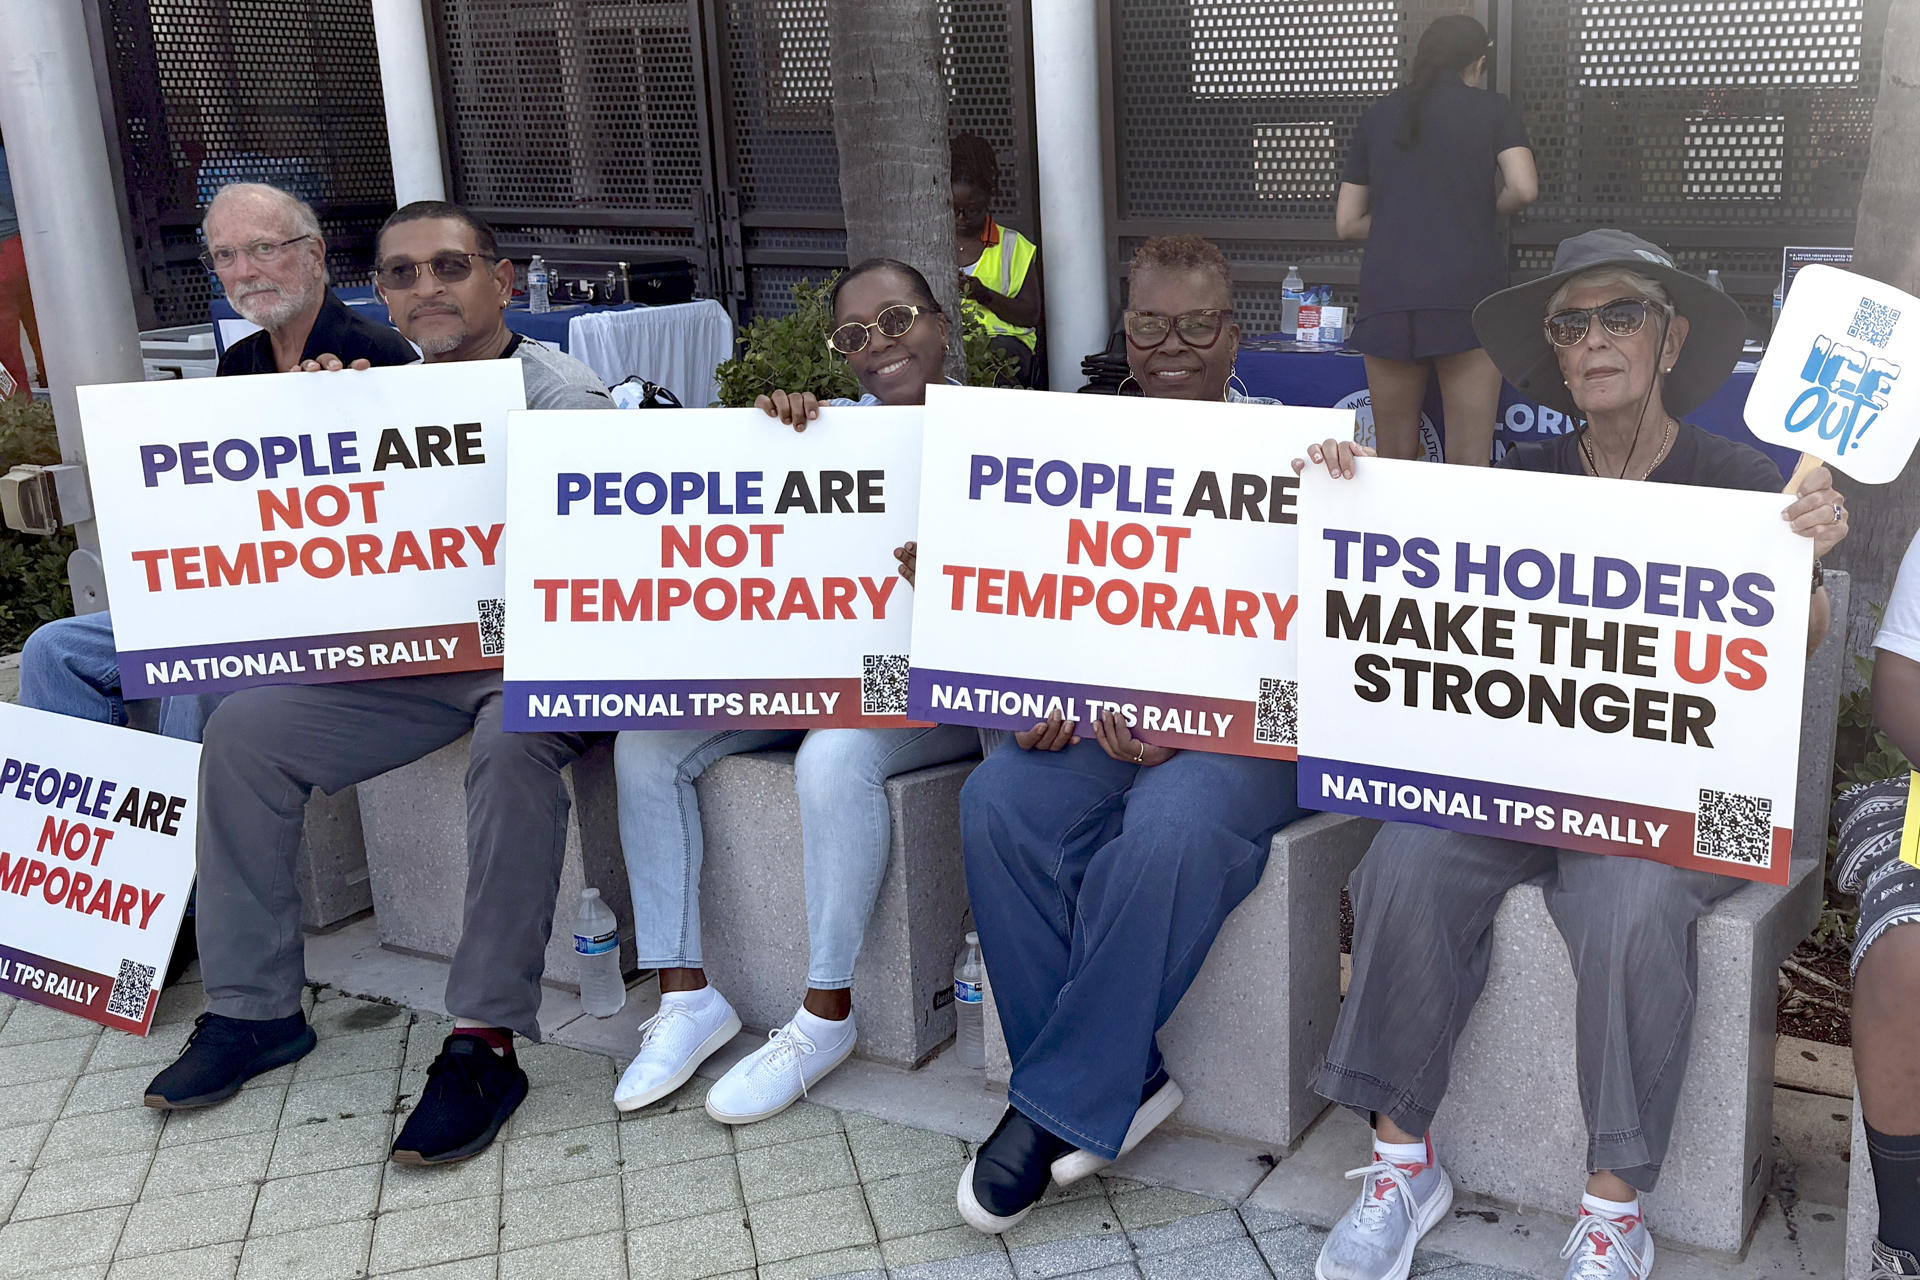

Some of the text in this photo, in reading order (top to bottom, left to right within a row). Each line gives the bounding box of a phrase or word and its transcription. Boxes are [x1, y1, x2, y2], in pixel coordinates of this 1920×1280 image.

[1800, 334, 1901, 411] ICE
[140, 422, 485, 487] PEOPLE ARE
[257, 481, 385, 531] NOT
[557, 470, 885, 515] PEOPLE ARE
[969, 454, 1300, 524] PEOPLE ARE
[131, 523, 505, 592] TEMPORARY
[661, 524, 784, 568] NOT
[1067, 518, 1191, 573] NOT
[1323, 528, 1775, 627] TPS HOLDERS
[533, 576, 899, 622] TEMPORARY
[943, 564, 1298, 641] TEMPORARY
[145, 637, 459, 685] NATIONAL TPS RALLY
[1325, 589, 1768, 691] MAKE THE US
[528, 691, 840, 718] NATIONAL TPS RALLY
[931, 684, 1080, 722] NATIONAL
[1142, 705, 1234, 738] RALLY
[1354, 653, 1716, 748] STRONGER
[0, 757, 187, 837] PEOPLE ARE
[1321, 772, 1669, 849] NATIONAL TPS RALLY
[36, 815, 115, 867] NOT
[0, 852, 165, 930] MPORARY
[14, 962, 45, 990] TPS
[44, 972, 99, 1006] RALLY
